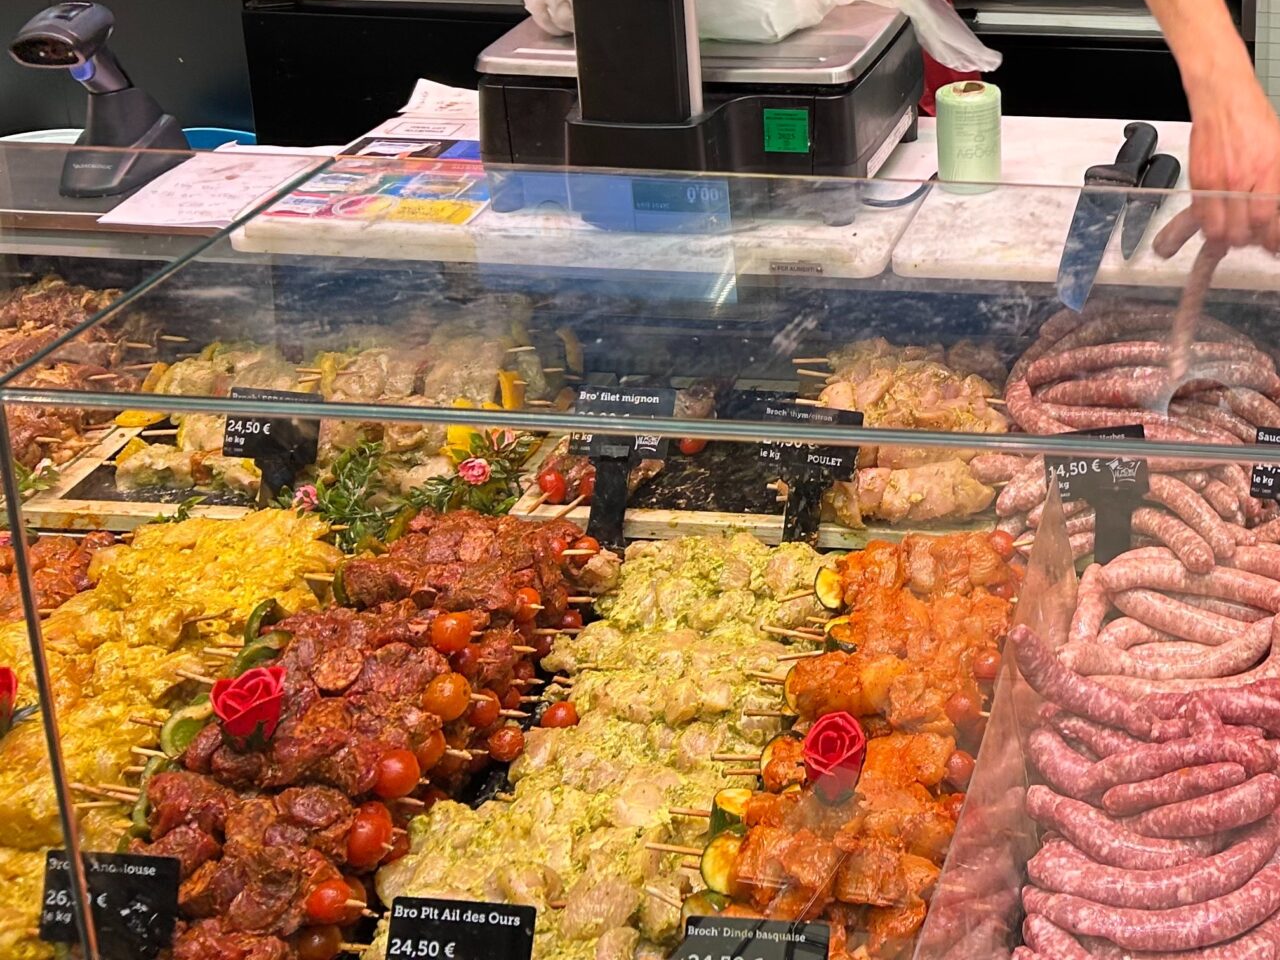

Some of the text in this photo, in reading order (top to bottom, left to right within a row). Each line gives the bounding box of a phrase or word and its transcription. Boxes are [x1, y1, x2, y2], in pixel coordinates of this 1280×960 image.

[600, 392, 620, 402] filet
[622, 394, 660, 405] mignon
[227, 419, 271, 435] 24,50 €
[225, 434, 246, 446] le kg
[572, 431, 594, 443] le kg
[769, 450, 781, 461] kg
[807, 454, 843, 467] POULET
[1048, 459, 1101, 479] 14,50 €
[1058, 480, 1070, 490] kg
[1253, 474, 1274, 487] le kg
[97, 892, 108, 908] €
[55, 911, 72, 924] kg
[394, 905, 418, 918] Bro
[441, 908, 460, 921] Ail
[463, 910, 486, 924] des
[488, 912, 520, 927] Ours
[723, 927, 753, 939] Dinde
[756, 930, 806, 943] basquaise
[390, 938, 456, 958] 24,50 €
